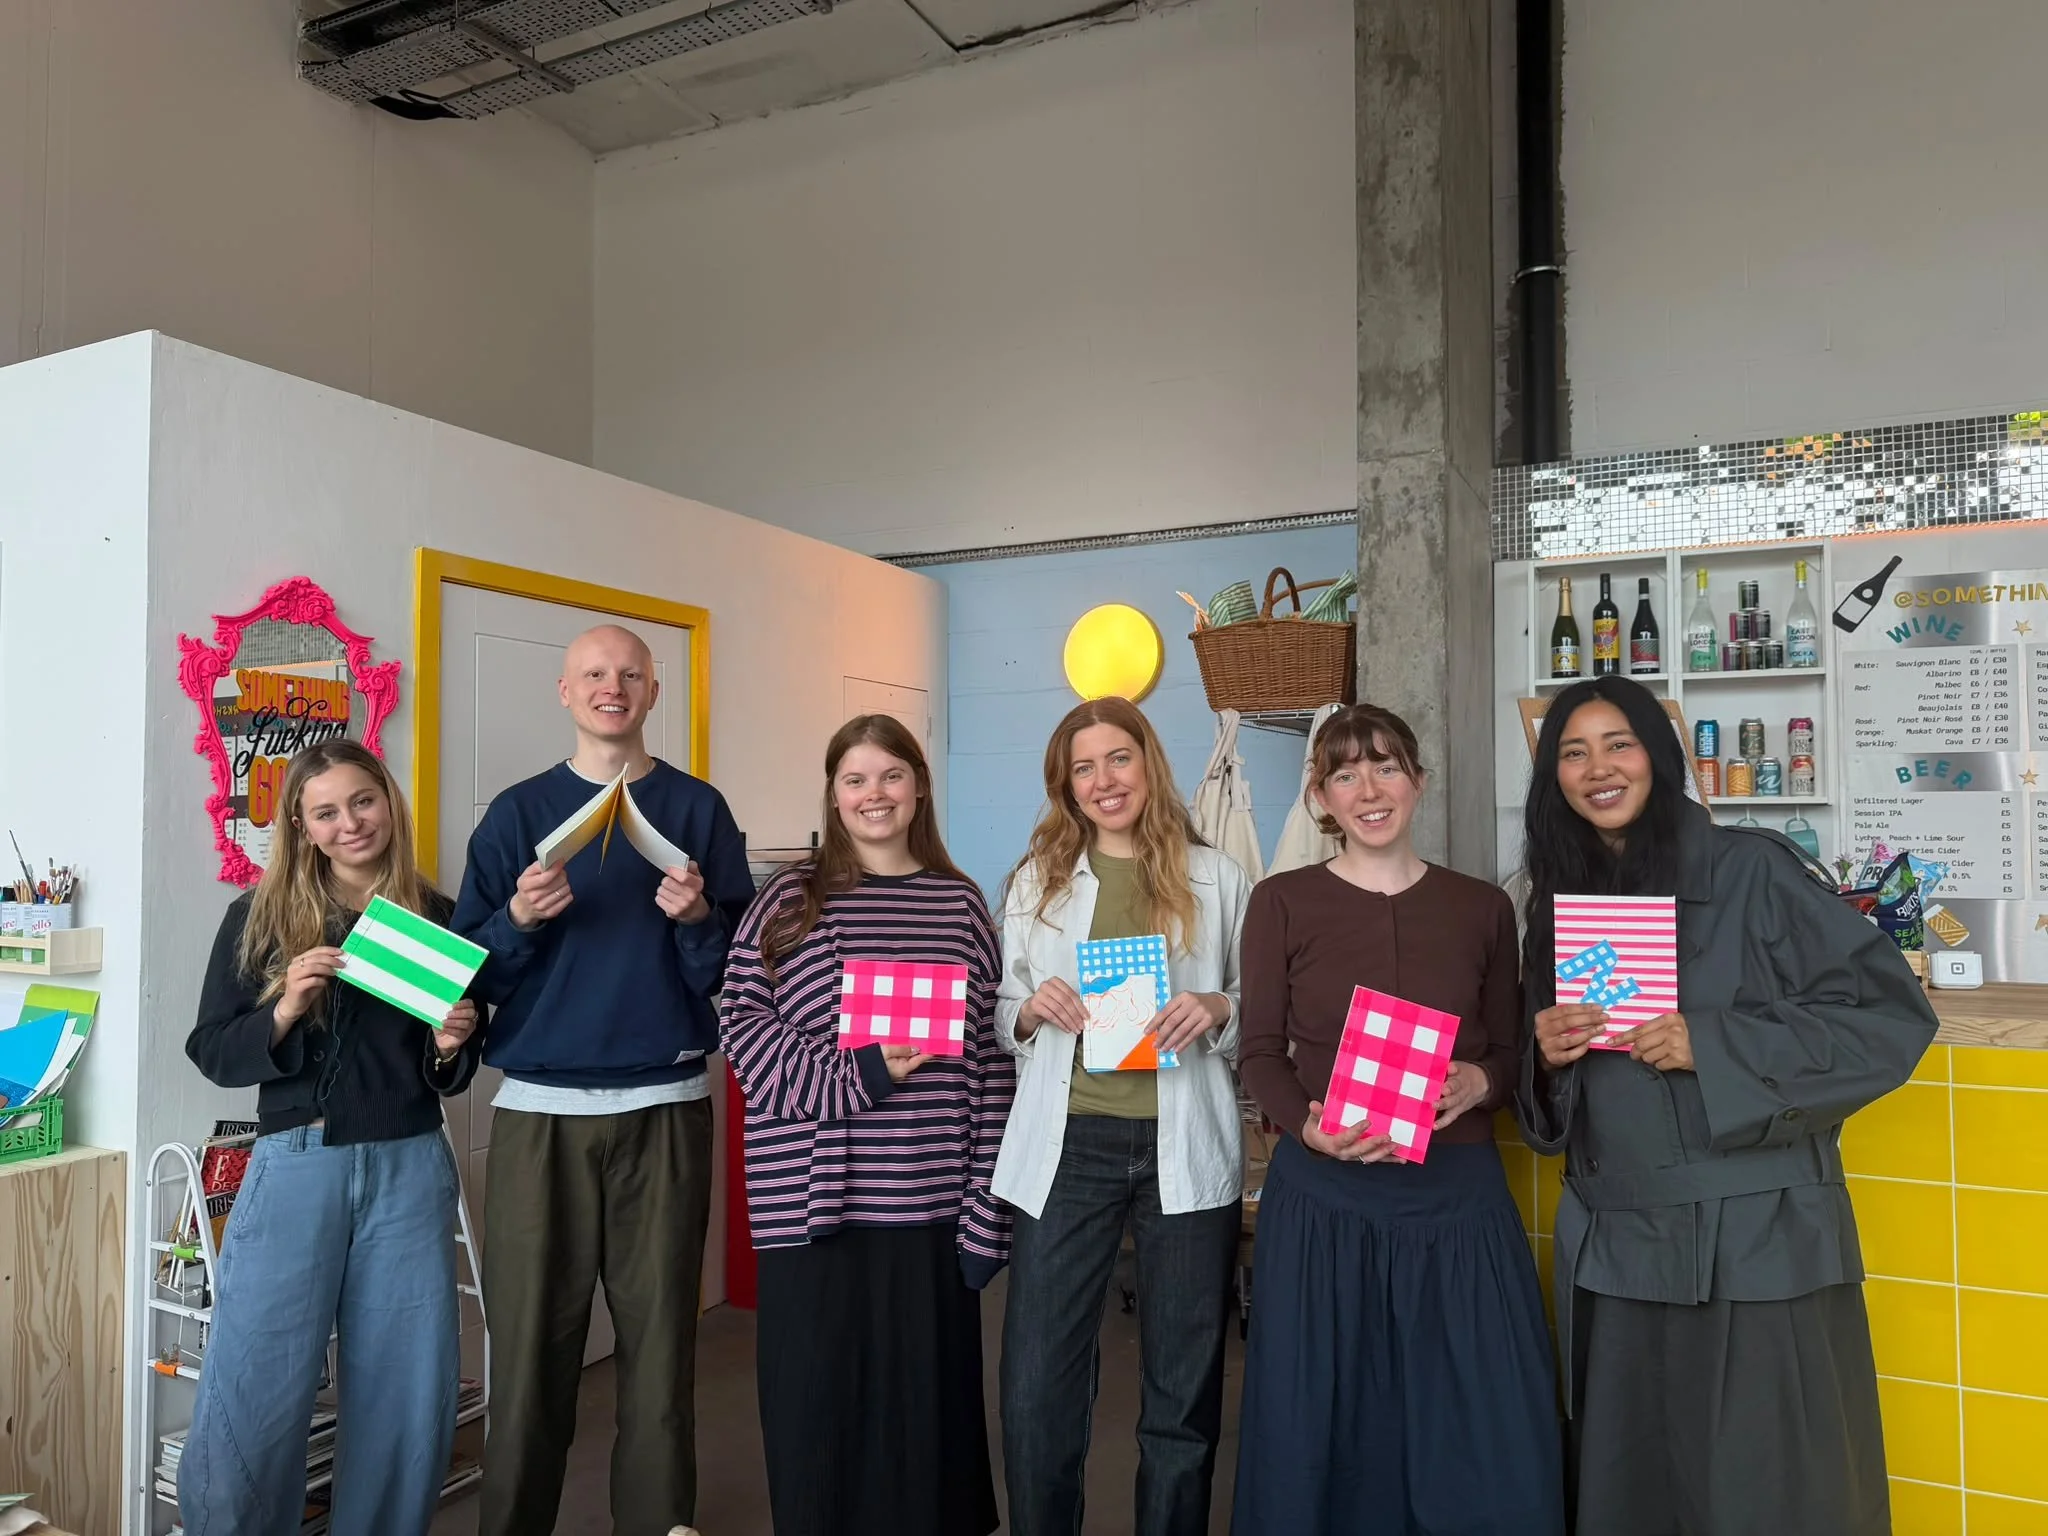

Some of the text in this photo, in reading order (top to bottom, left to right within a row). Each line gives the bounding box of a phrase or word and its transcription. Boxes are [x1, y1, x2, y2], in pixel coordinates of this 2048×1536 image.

[1886, 614, 1965, 644] WINE
[1896, 660, 1935, 668] Sauvignon
[1938, 658, 1961, 666] Blanc
[236, 668, 350, 722] SOMETHING
[1918, 704, 1963, 712] Beaujolais
[1855, 729, 1884, 737] Orange:
[1936, 727, 1963, 735] Orange
[1855, 740, 1897, 748] Sparkling:
[1896, 759, 1972, 790] BEER
[1897, 846, 1934, 854] Cherries
[1937, 846, 1960, 854] Cider
